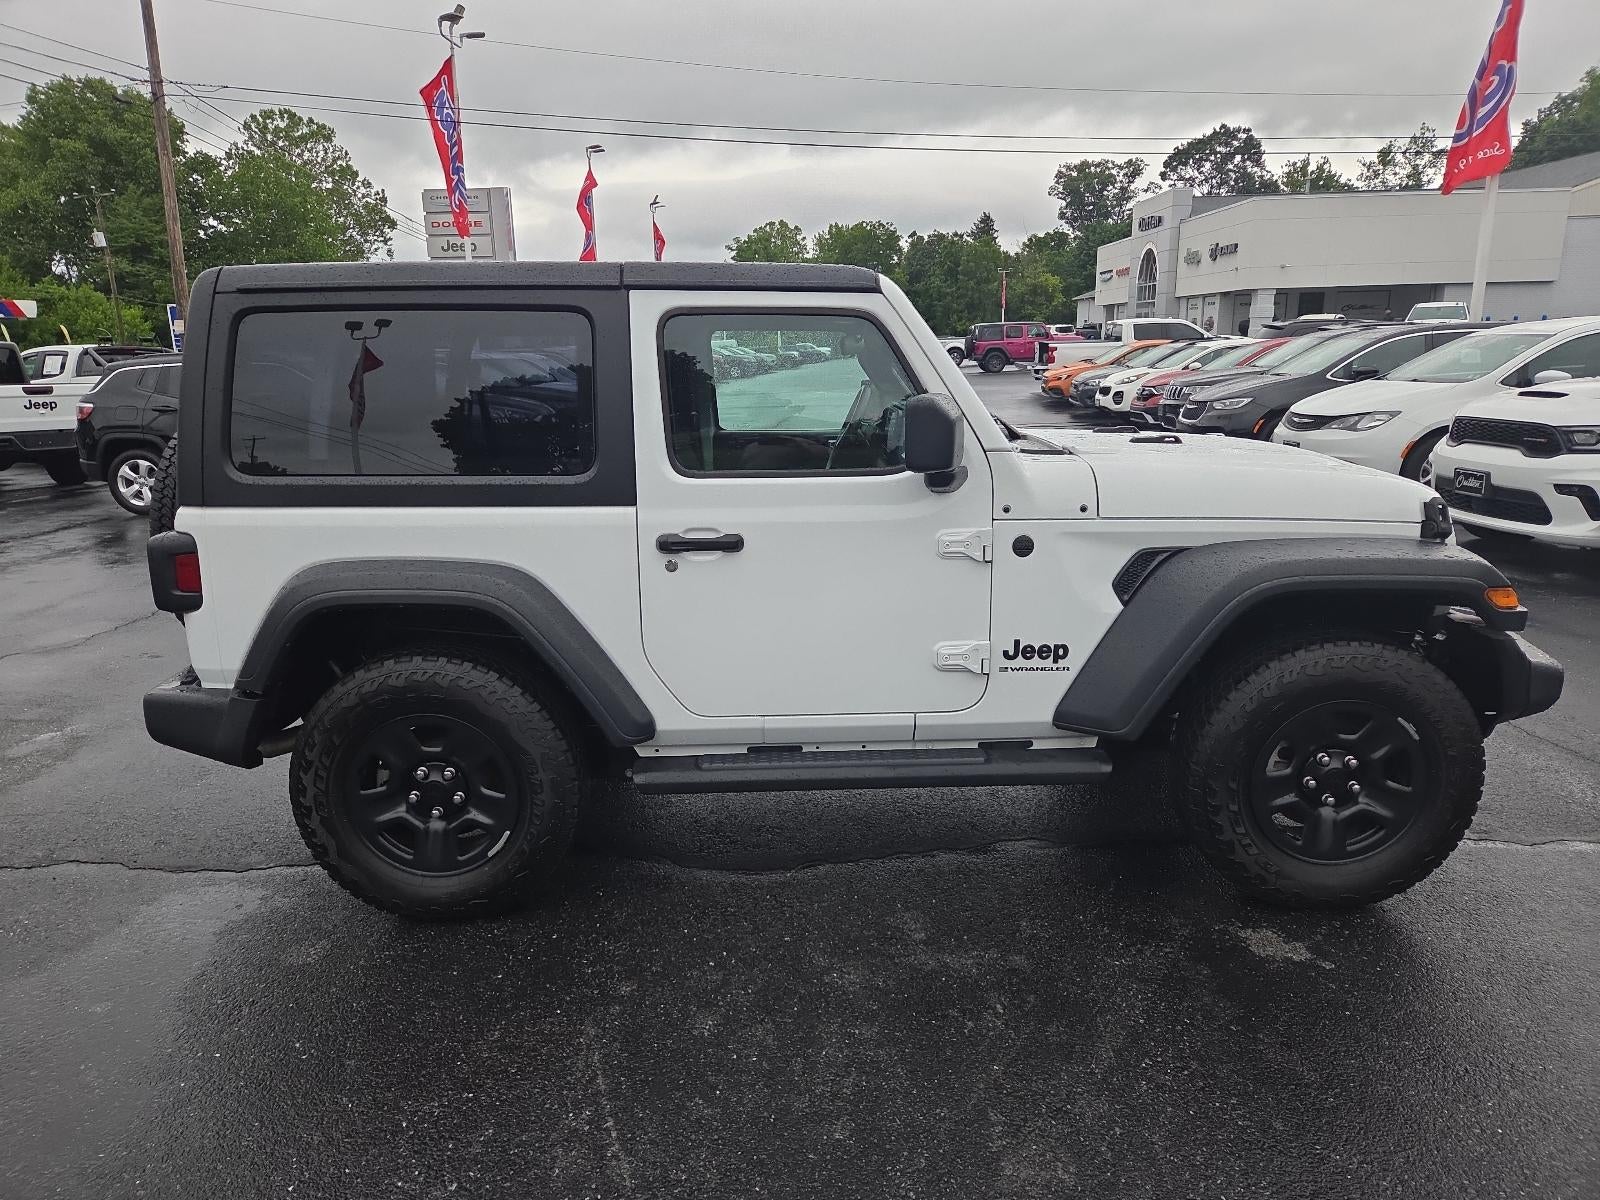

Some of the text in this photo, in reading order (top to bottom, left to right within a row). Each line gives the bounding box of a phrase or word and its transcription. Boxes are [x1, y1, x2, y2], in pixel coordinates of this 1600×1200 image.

[431, 220, 483, 228] DOE
[23, 399, 58, 411] Jeep
[1002, 638, 1070, 664] Jeep
